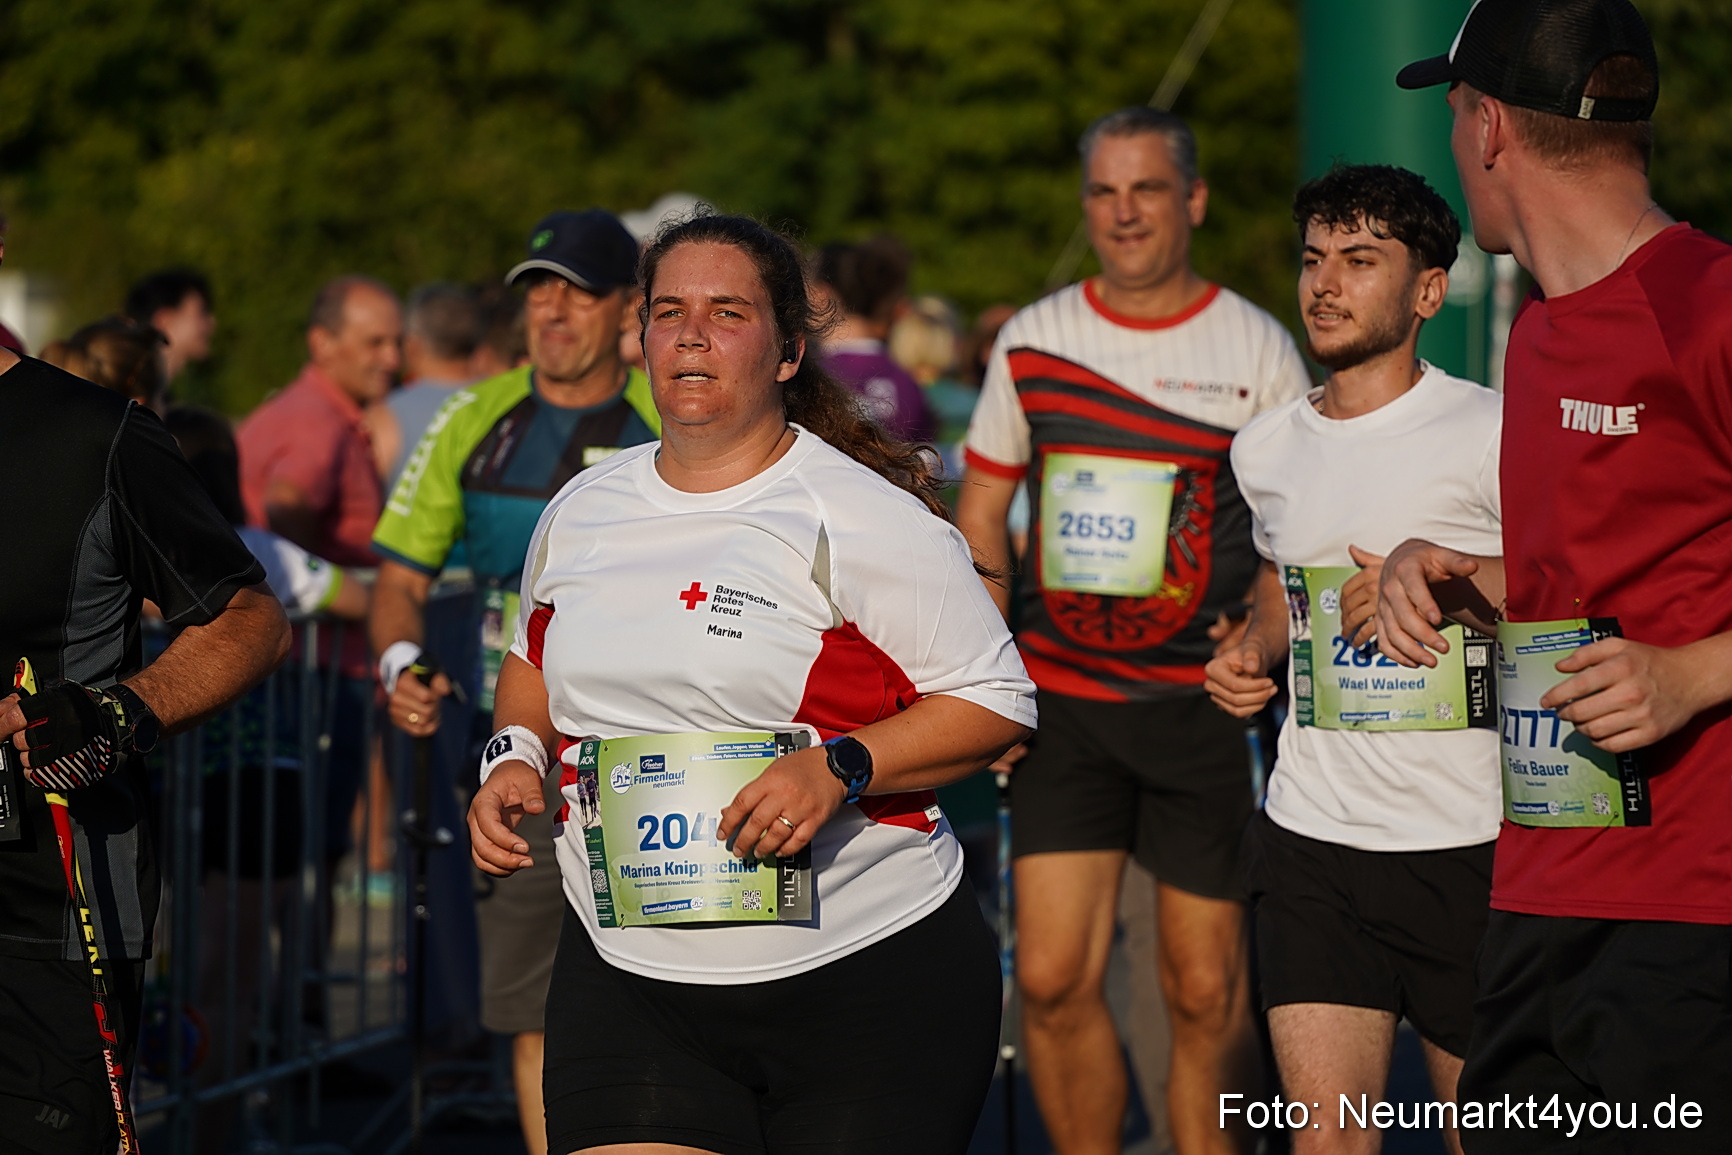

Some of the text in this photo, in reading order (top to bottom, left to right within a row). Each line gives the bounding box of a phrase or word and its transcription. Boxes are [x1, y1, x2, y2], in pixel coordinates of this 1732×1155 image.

[1560, 398, 1639, 435] THULE
[1058, 511, 1135, 542] 2653
[713, 595, 744, 607] Rotes
[715, 584, 778, 610] Bayerisches
[710, 604, 742, 617] Kreuz
[707, 624, 743, 639] Marina
[1338, 676, 1425, 690] Wael Waleed
[1471, 669, 1484, 718] HILTL
[1501, 704, 1560, 748] 2777
[580, 755, 595, 765] AOK
[1508, 757, 1570, 777] Felix Bauer
[633, 769, 686, 785] Firmenlauf
[652, 779, 685, 789] neumarkt
[637, 812, 718, 851] 204
[619, 858, 758, 880] Marina Knippschild
[643, 902, 689, 913] firmenlauf.bayern
[79, 908, 103, 975] LEKI
[103, 1049, 123, 1112] WALKER
